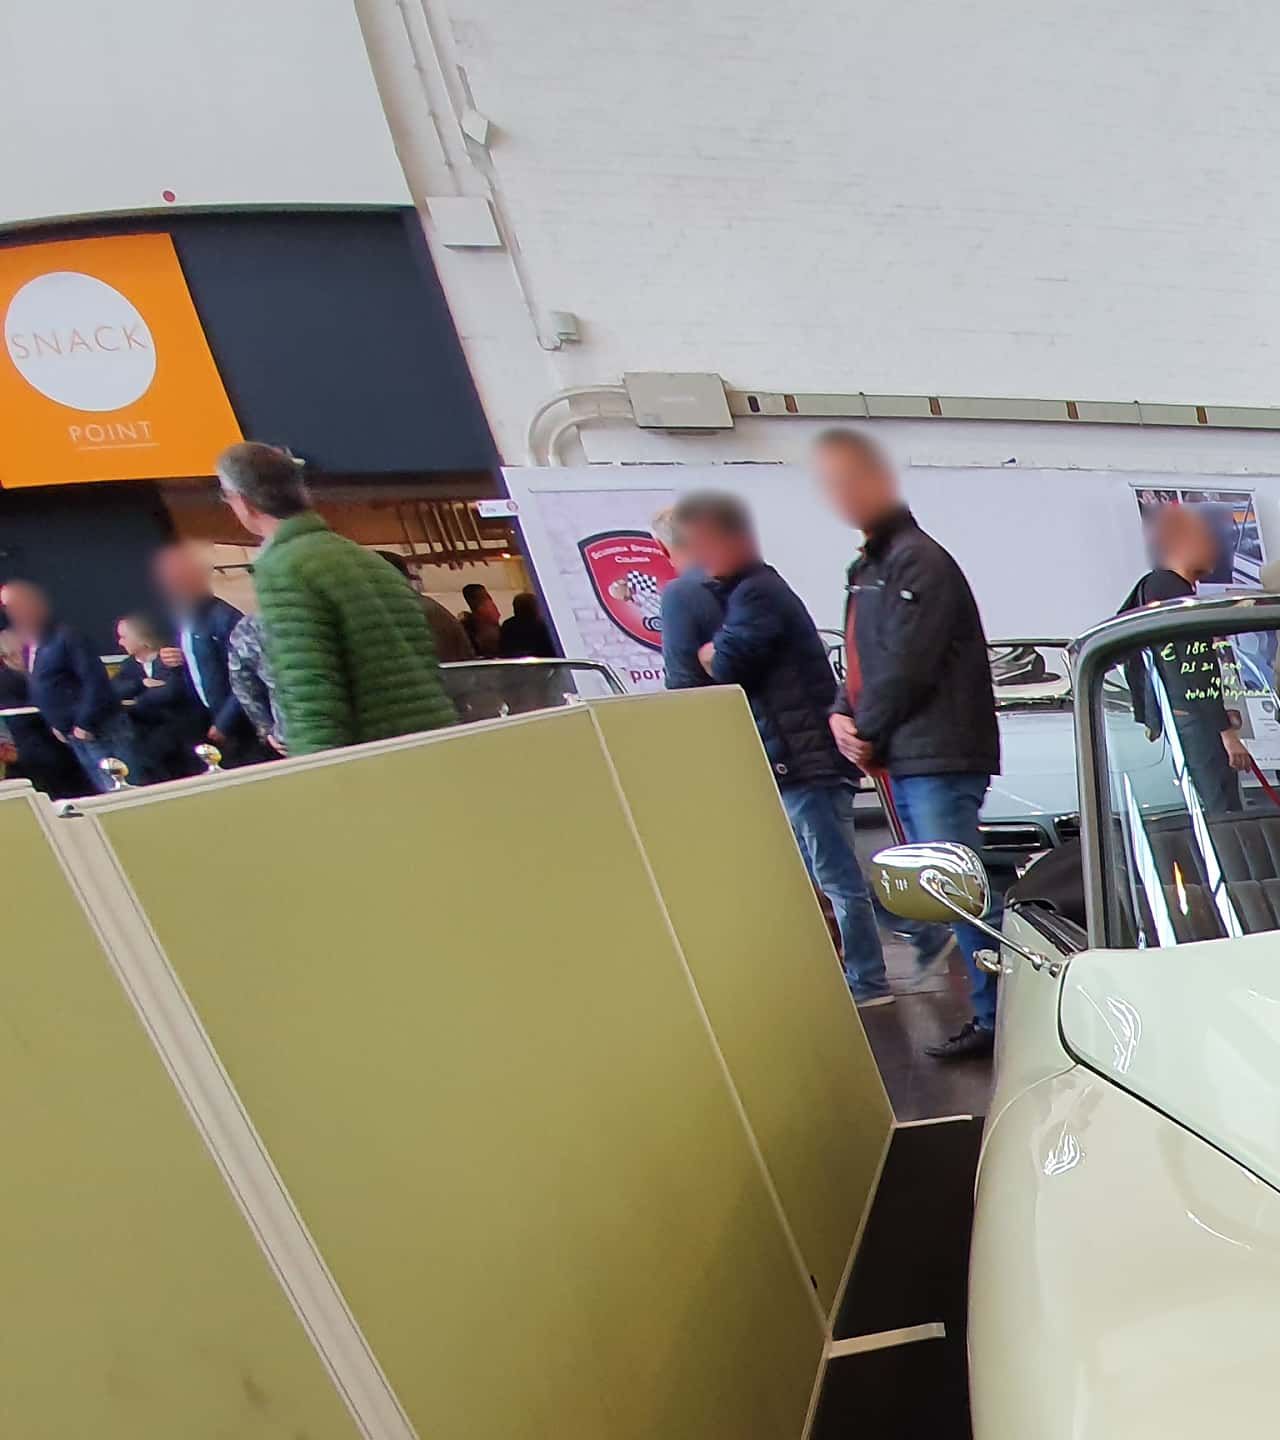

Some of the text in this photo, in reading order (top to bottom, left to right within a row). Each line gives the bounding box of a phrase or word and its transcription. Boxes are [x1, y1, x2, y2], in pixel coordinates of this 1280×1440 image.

[11, 322, 148, 360] SNACK
[68, 420, 152, 444] POINT
[1160, 642, 1176, 660] €
[1180, 661, 1196, 675] DS
[1184, 687, 1220, 702] totally
